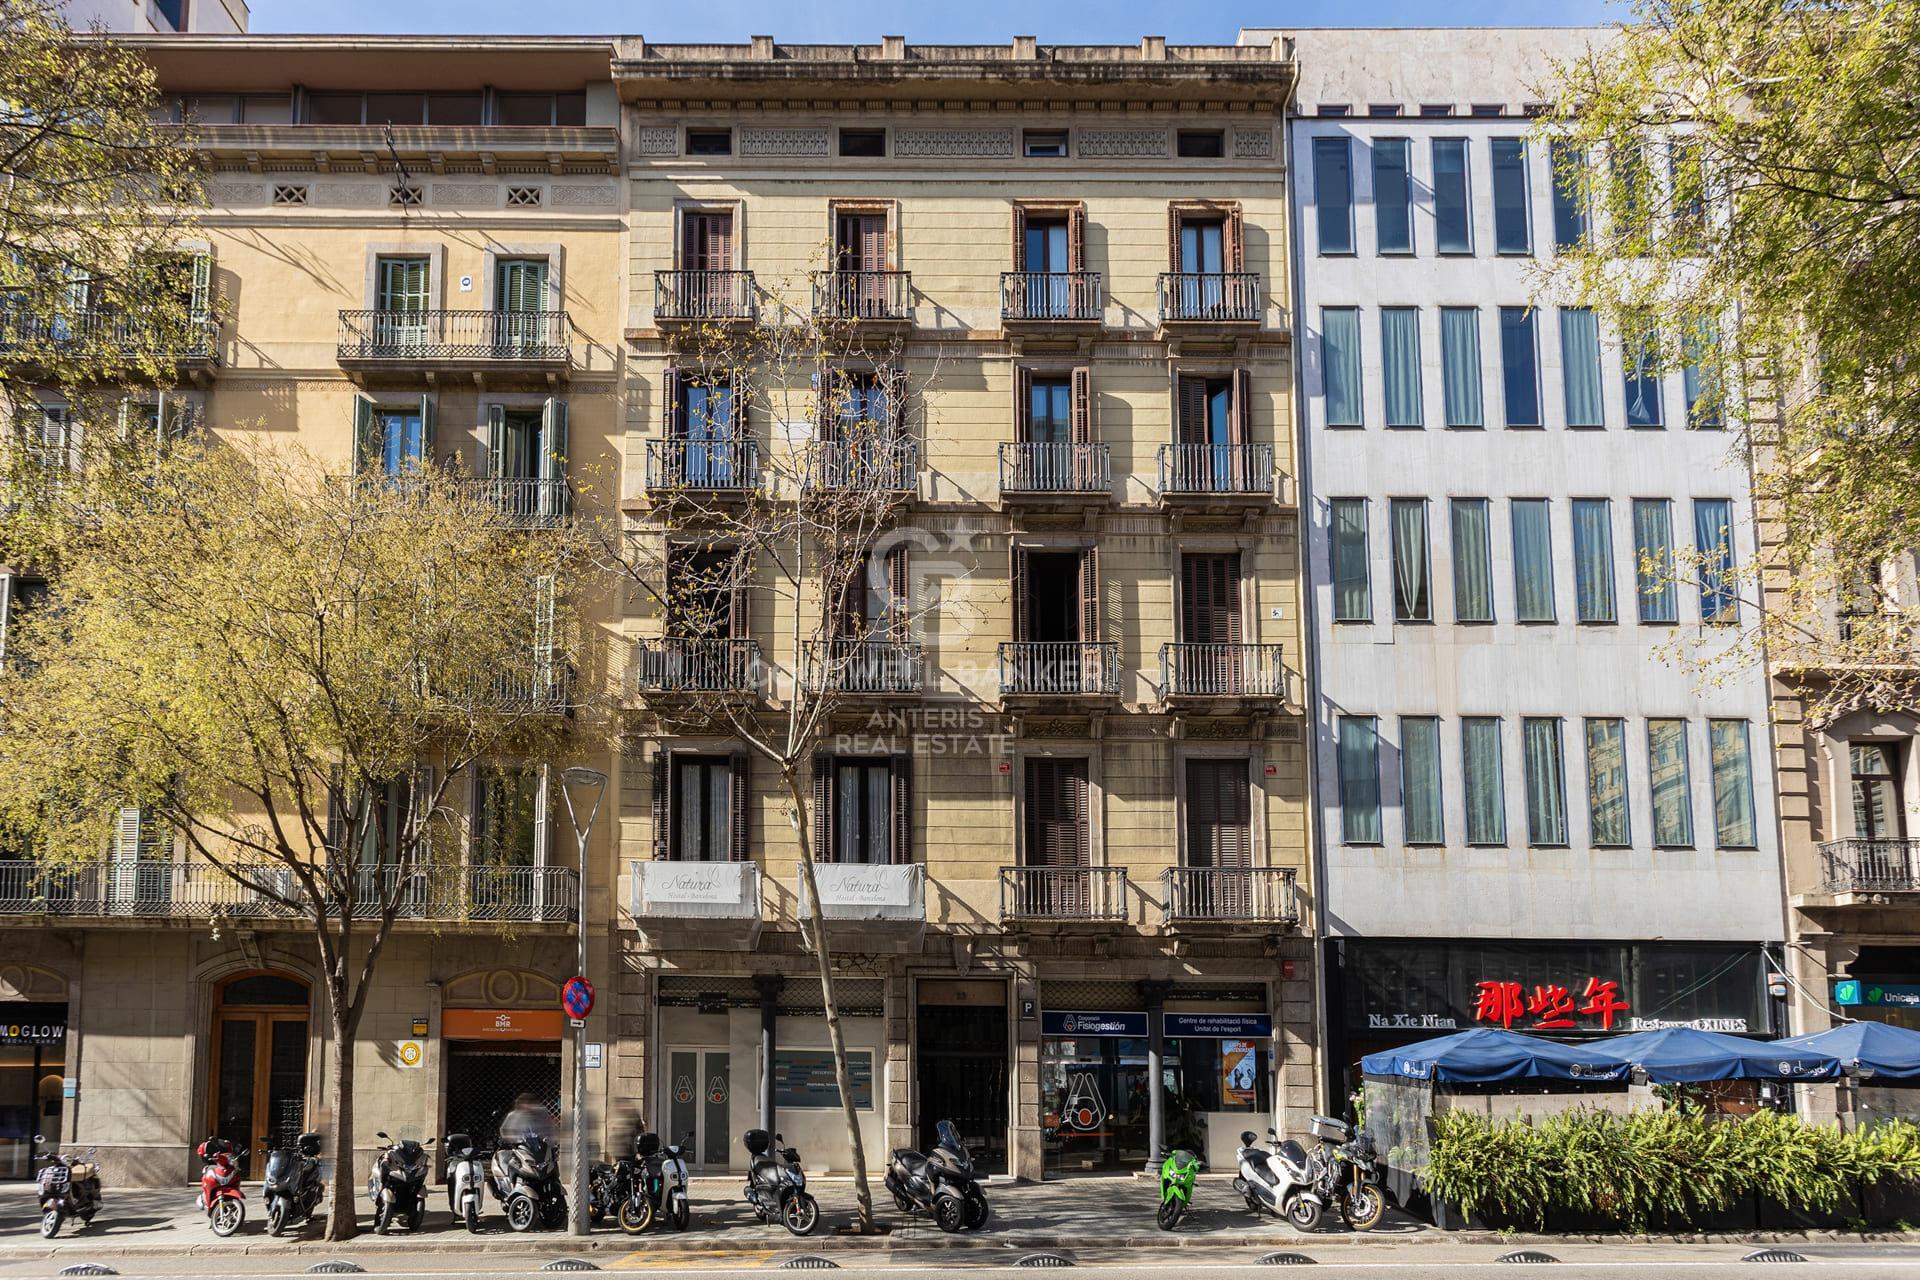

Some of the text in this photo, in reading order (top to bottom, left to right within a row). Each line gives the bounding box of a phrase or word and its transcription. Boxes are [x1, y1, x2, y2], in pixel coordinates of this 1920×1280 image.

[661, 873, 713, 892] Natura
[830, 876, 881, 893] Natura
[1472, 976, 1630, 1030] 那些年
[1884, 992, 1920, 1005] Unicaja
[1368, 1013, 1456, 1028] Na Xie Nian
